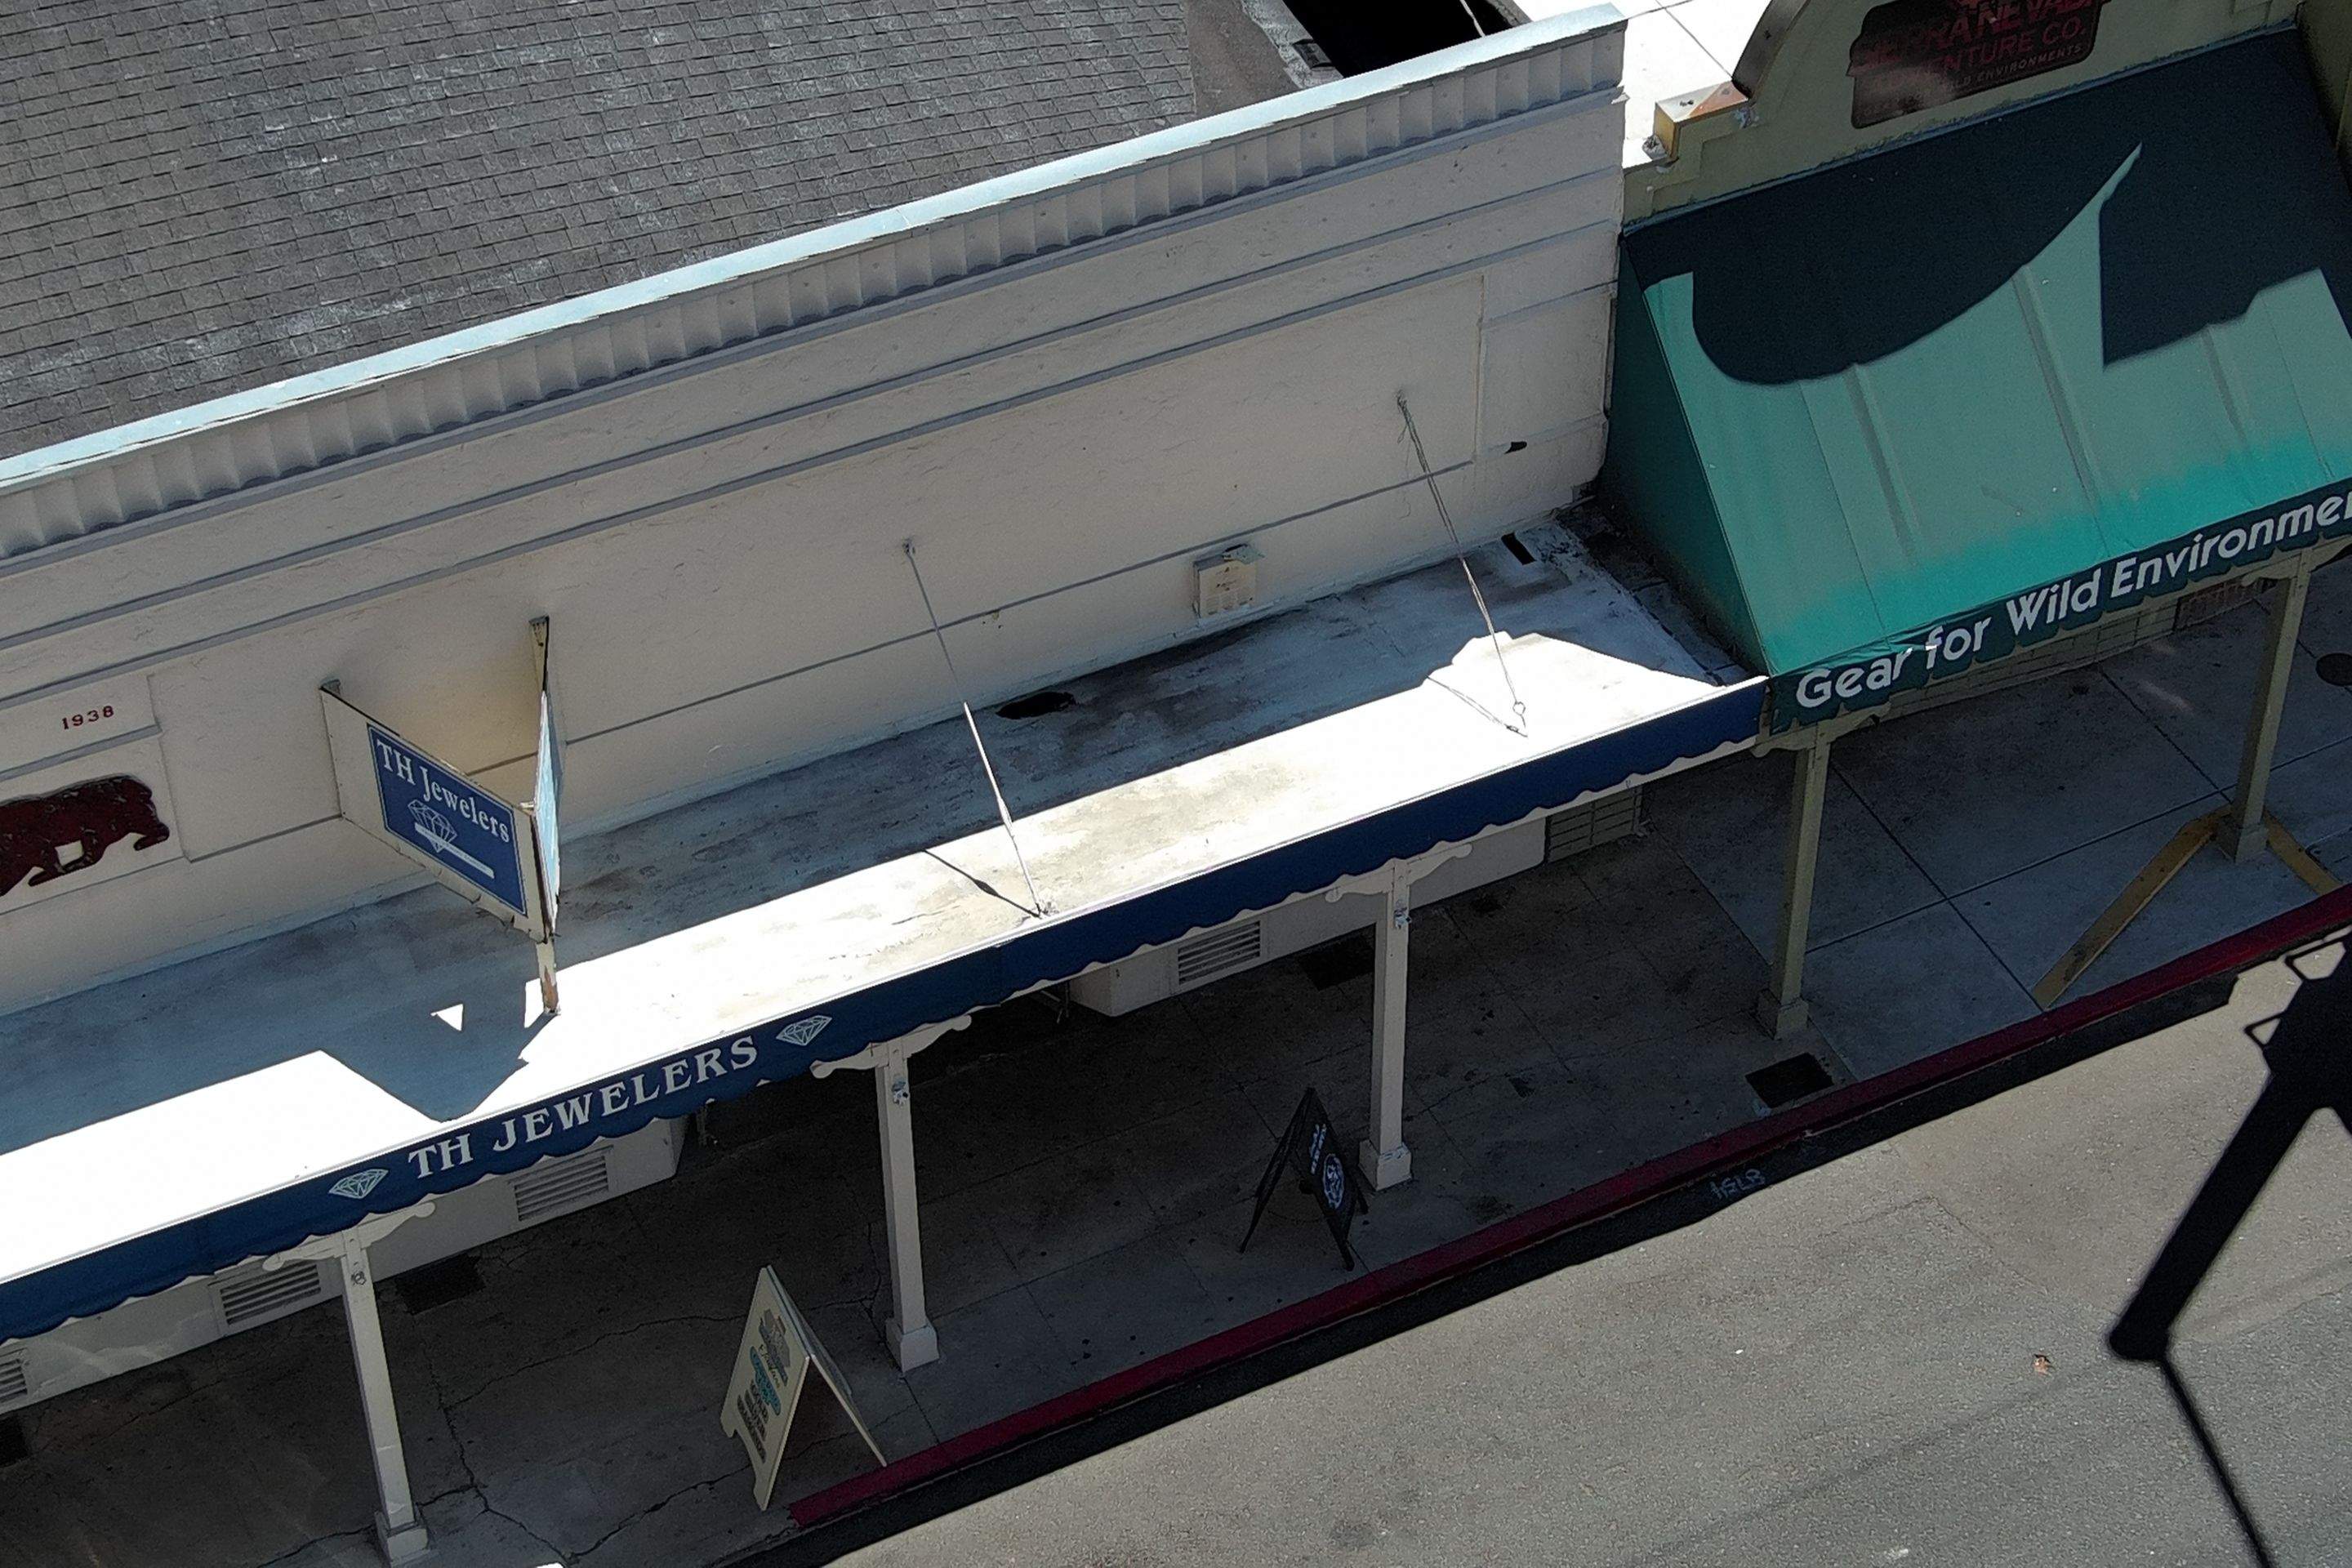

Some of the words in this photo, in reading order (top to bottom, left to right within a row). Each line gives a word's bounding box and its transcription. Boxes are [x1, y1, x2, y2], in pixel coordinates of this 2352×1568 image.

[1796, 646, 1913, 709] Gear
[1924, 615, 1993, 670] for
[2006, 568, 2102, 635] Wild
[61, 705, 114, 730] 1938
[376, 738, 416, 786] TH
[419, 766, 510, 843] Jewelers
[408, 1132, 474, 1180] TH
[492, 1035, 758, 1152] JEWELERS
